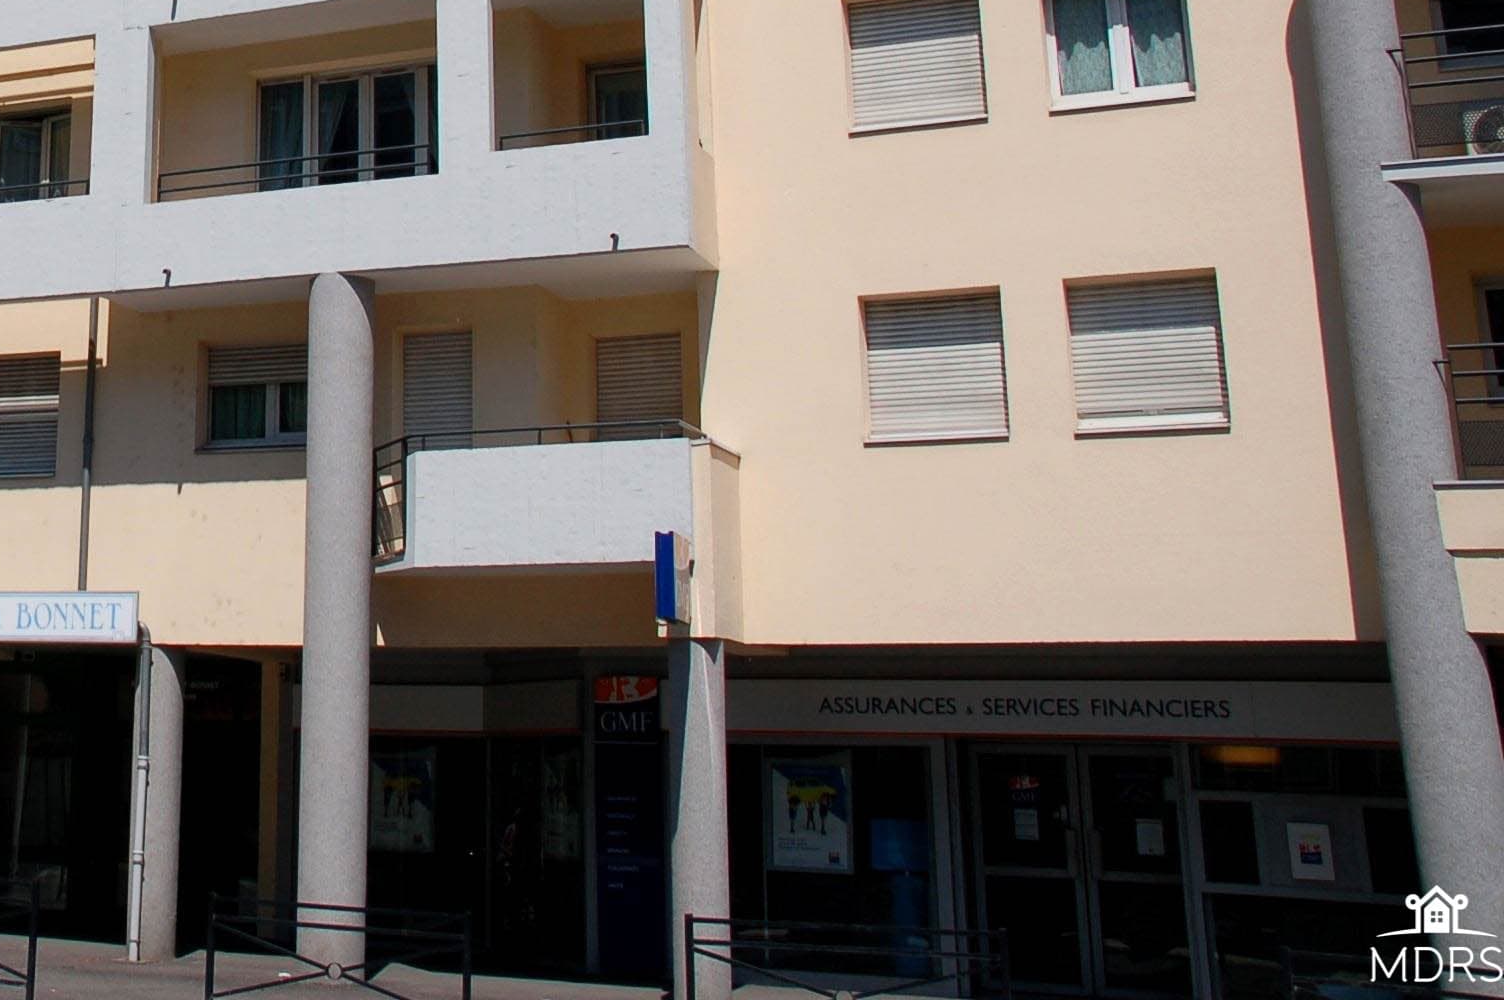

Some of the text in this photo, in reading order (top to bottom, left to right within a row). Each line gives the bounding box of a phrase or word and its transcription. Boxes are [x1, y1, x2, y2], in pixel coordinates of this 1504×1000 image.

[16, 602, 122, 631] BONNET
[818, 697, 958, 715] ASSURANCES
[982, 697, 1080, 717] SERVICES
[1090, 698, 1231, 719] FINANCIERS
[600, 711, 654, 733] GMF
